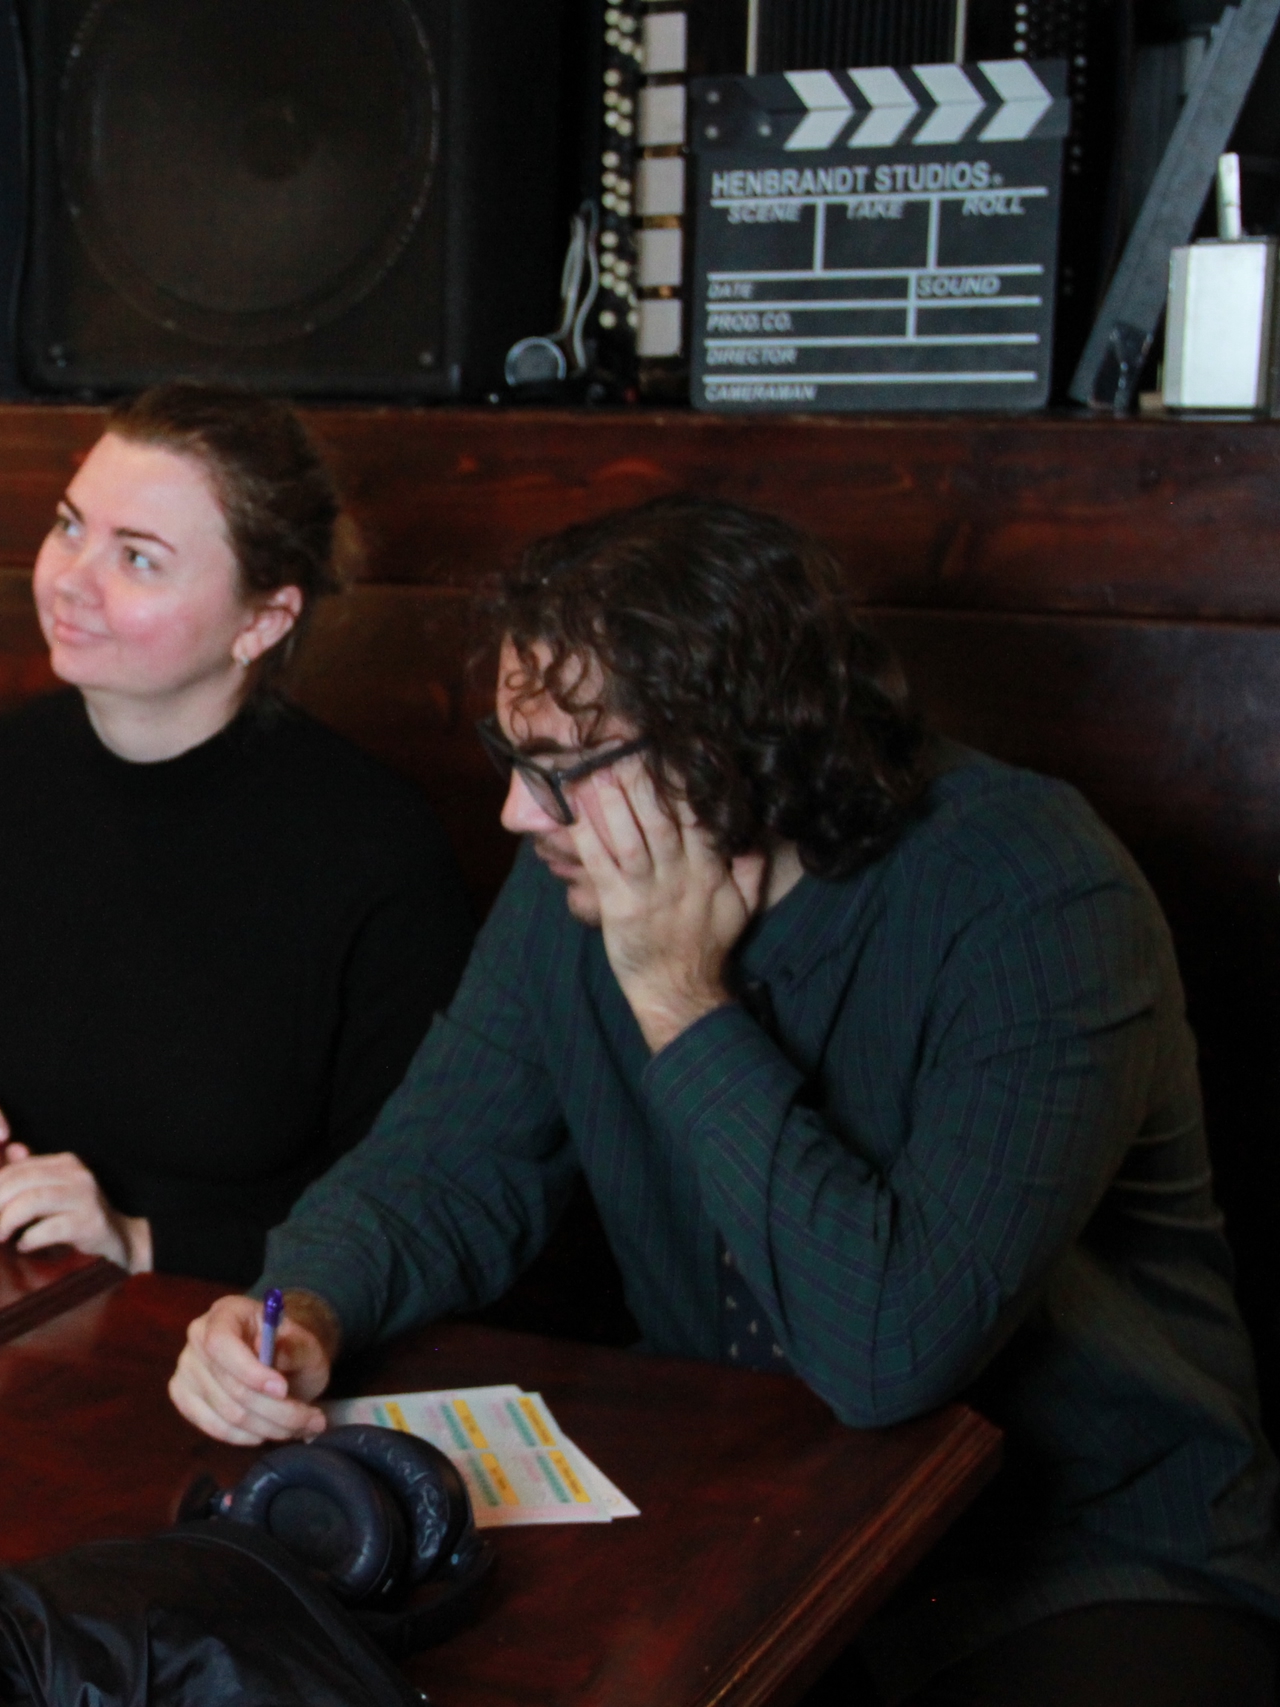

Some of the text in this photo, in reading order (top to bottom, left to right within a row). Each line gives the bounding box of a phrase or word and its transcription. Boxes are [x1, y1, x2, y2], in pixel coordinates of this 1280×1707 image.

[711, 166, 869, 196] HENBRANDT
[727, 200, 802, 224] SCENE
[846, 198, 906, 220] TAKE
[962, 193, 1026, 216] ROLL
[707, 281, 754, 300] DATE
[917, 276, 1001, 297] SOUND
[706, 347, 798, 366] DIRECTOR
[705, 384, 818, 402] CAMERAMAN
